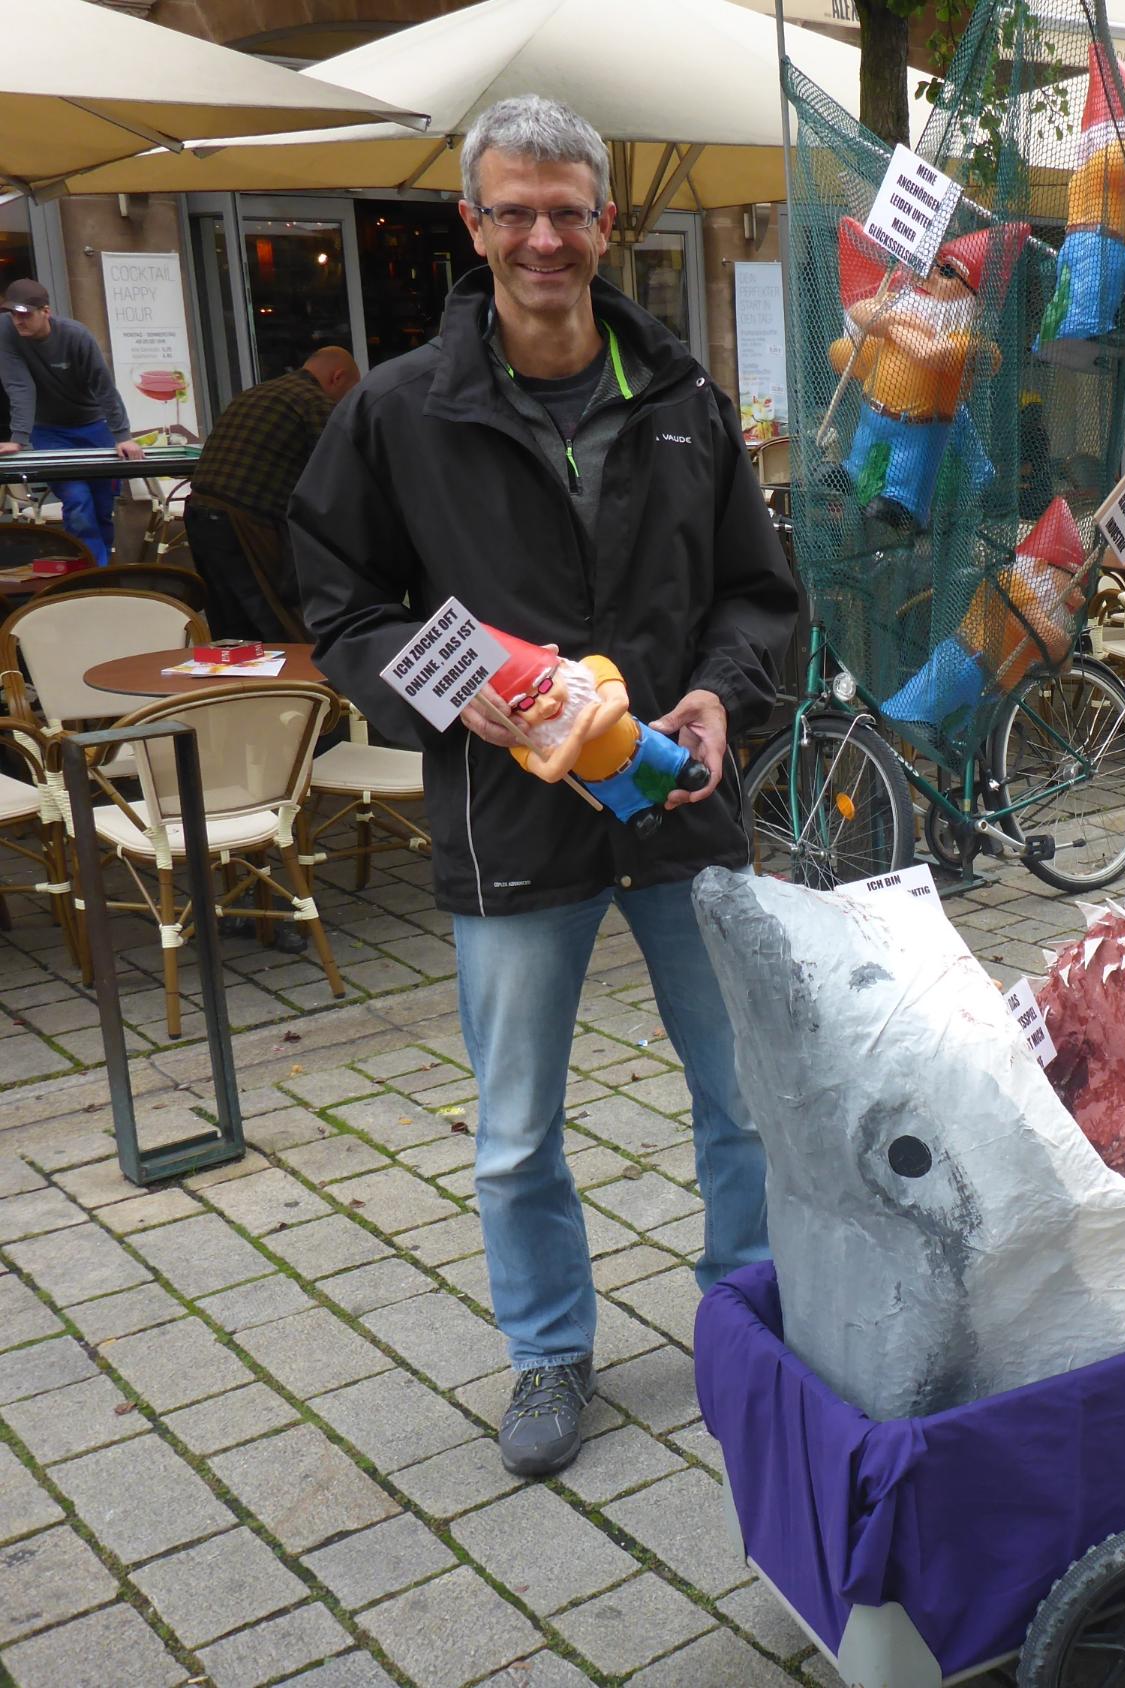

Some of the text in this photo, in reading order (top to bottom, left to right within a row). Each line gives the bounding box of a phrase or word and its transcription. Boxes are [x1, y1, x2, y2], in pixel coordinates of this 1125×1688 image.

[916, 164, 937, 187] MEINE
[896, 174, 942, 213] ANGEHÖRIGEN
[889, 193, 913, 222] LEIDEN
[891, 217, 917, 243] MEINER
[111, 264, 176, 282] COCKTAIL
[113, 286, 157, 302] HAPPY
[116, 306, 153, 321] HOUR
[662, 433, 692, 444] VAUDE
[393, 608, 458, 679] ICH ZOCKE OFT
[404, 659, 440, 697] ONLINE
[438, 636, 462, 660] DAS
[457, 619, 476, 640] IST
[432, 648, 479, 698] HERRLICH
[450, 665, 489, 708] BEQUEM
[867, 874, 901, 892] ICH BIN
